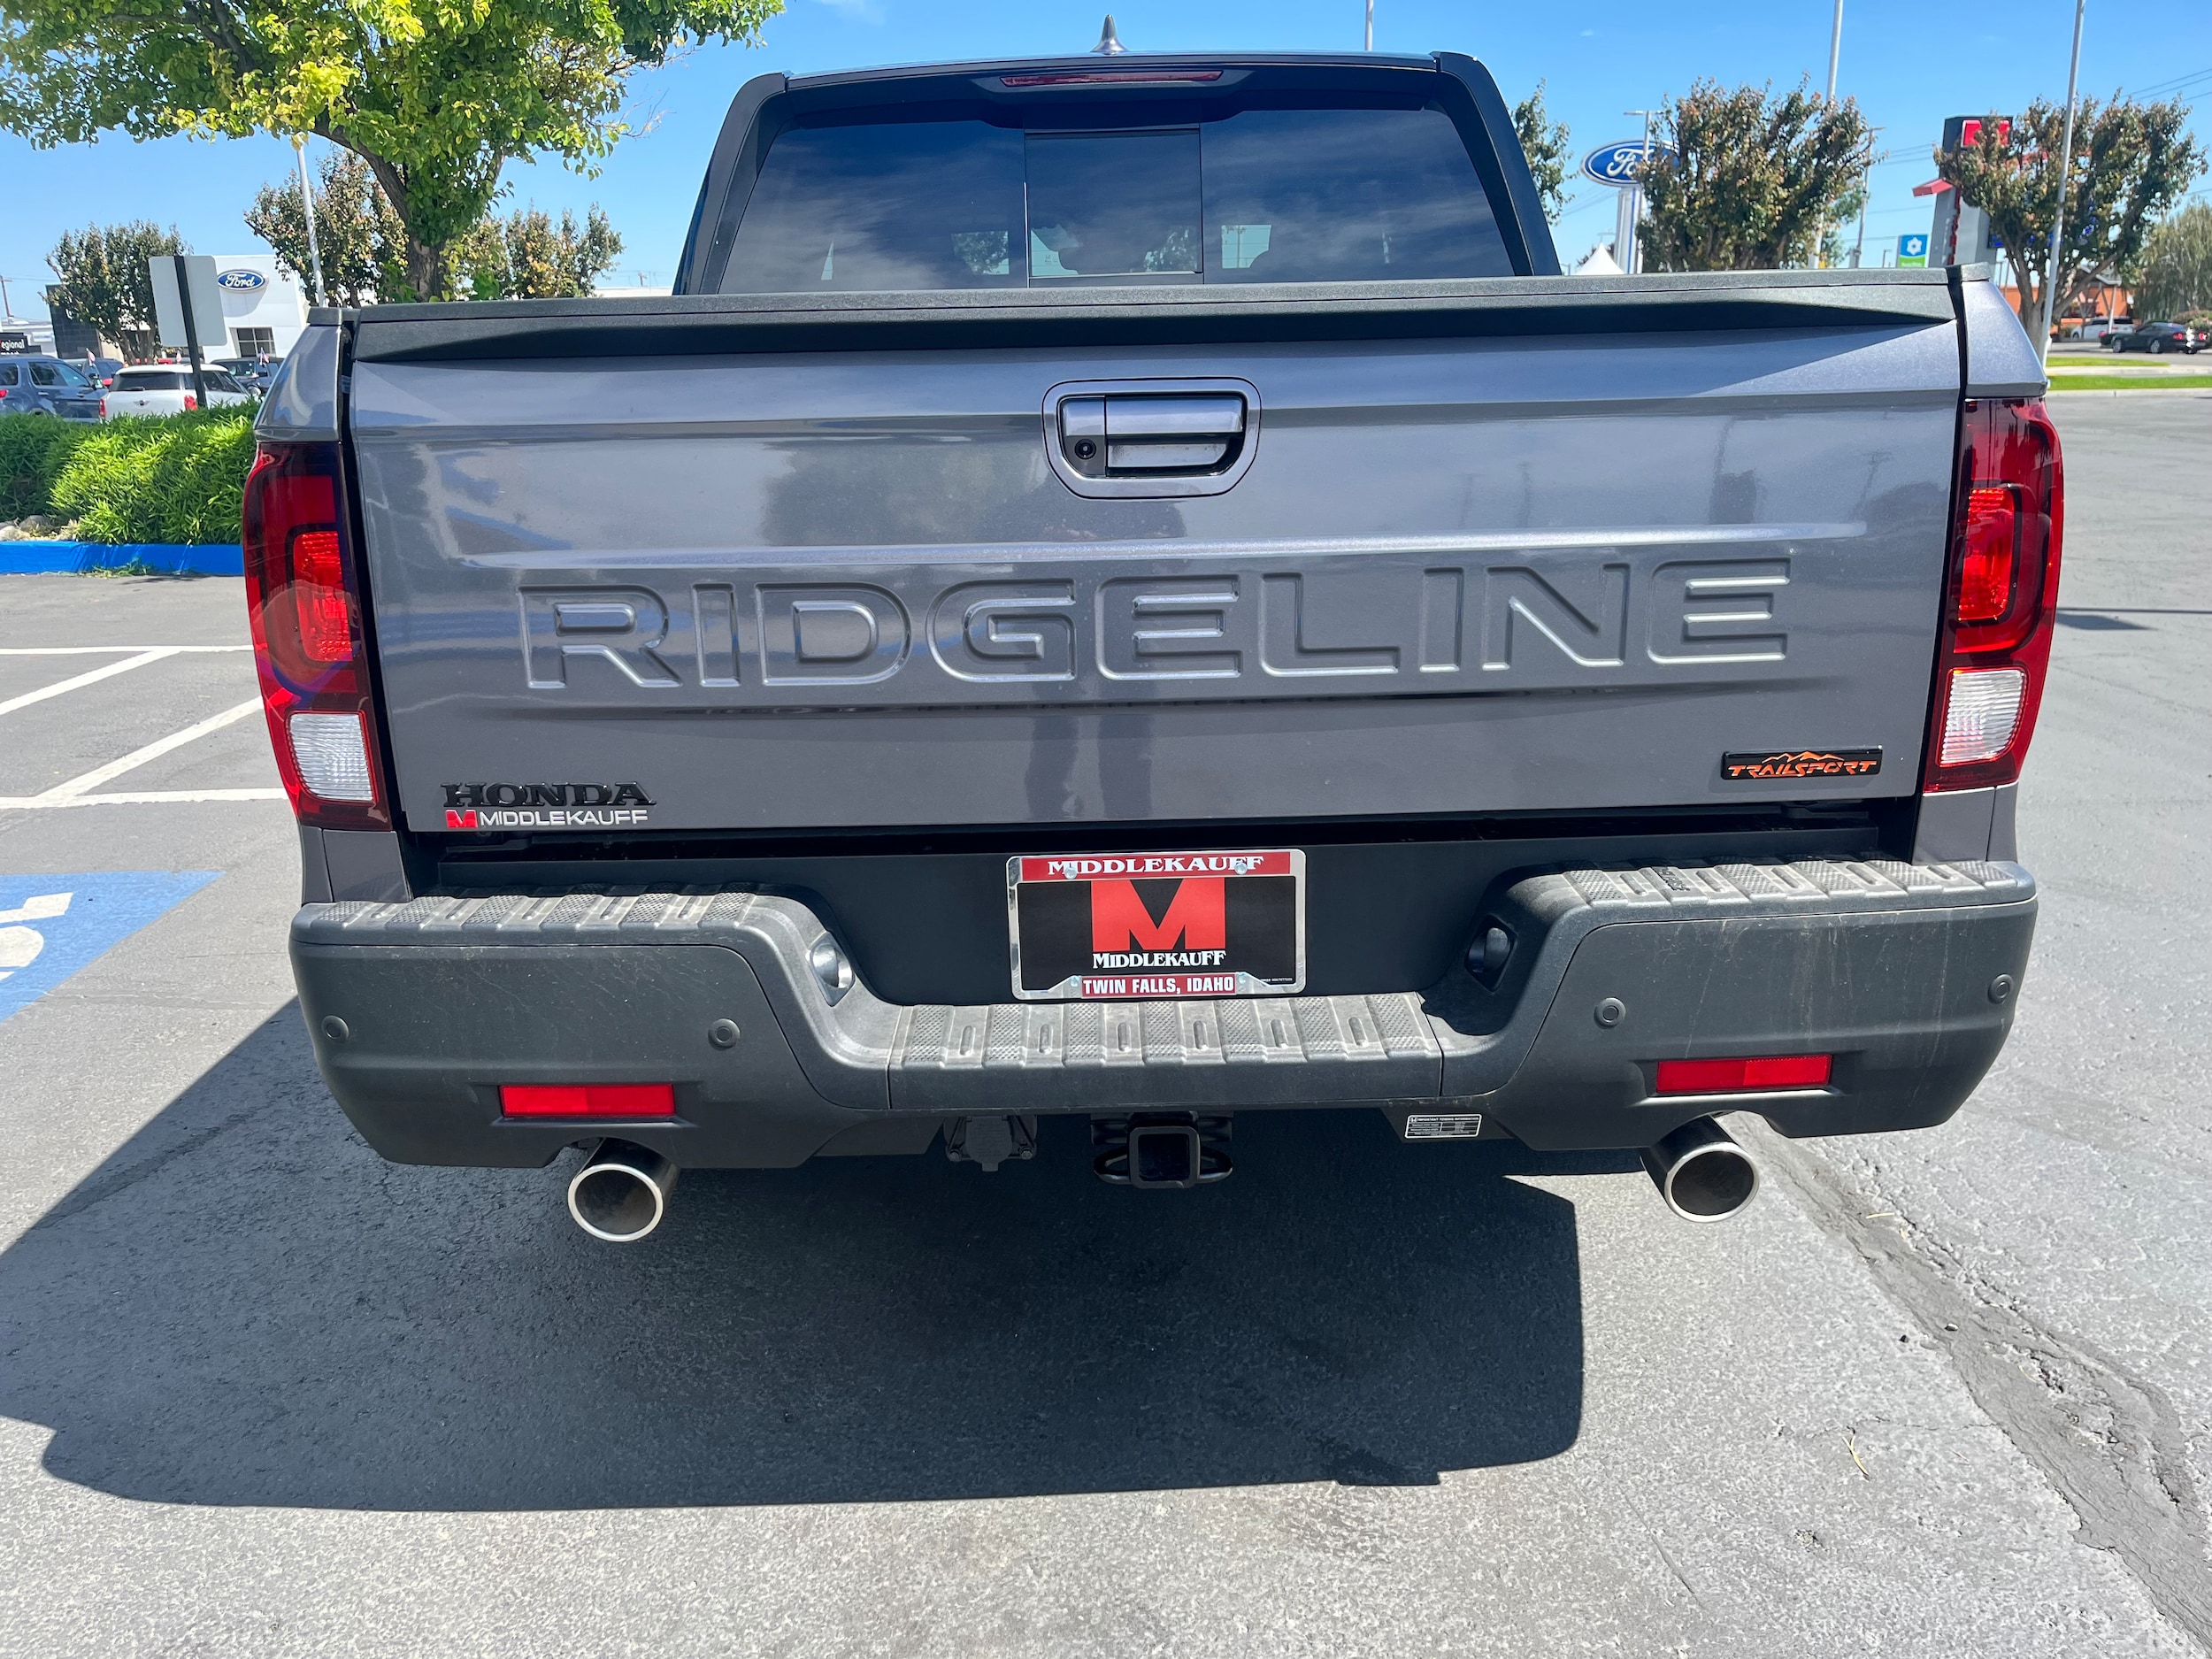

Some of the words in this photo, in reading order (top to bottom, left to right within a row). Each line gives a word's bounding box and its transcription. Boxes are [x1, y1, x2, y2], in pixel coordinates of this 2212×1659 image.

[225, 273, 255, 287] Ford
[0, 339, 25, 351] egional
[516, 557, 1791, 689] RIDGELINE
[1728, 760, 1877, 779] TRAILSPORT
[441, 782, 657, 808] HONDA
[480, 810, 649, 826] MIDDLEKAUFF
[1048, 856, 1264, 876] MIDDLEKAUFF
[1091, 877, 1225, 952] M
[1093, 950, 1226, 969] MIDDLEKAUFF
[1083, 979, 1126, 994] TWIN
[1132, 978, 1181, 995] FALLS,
[1187, 976, 1234, 992] IDAHO
